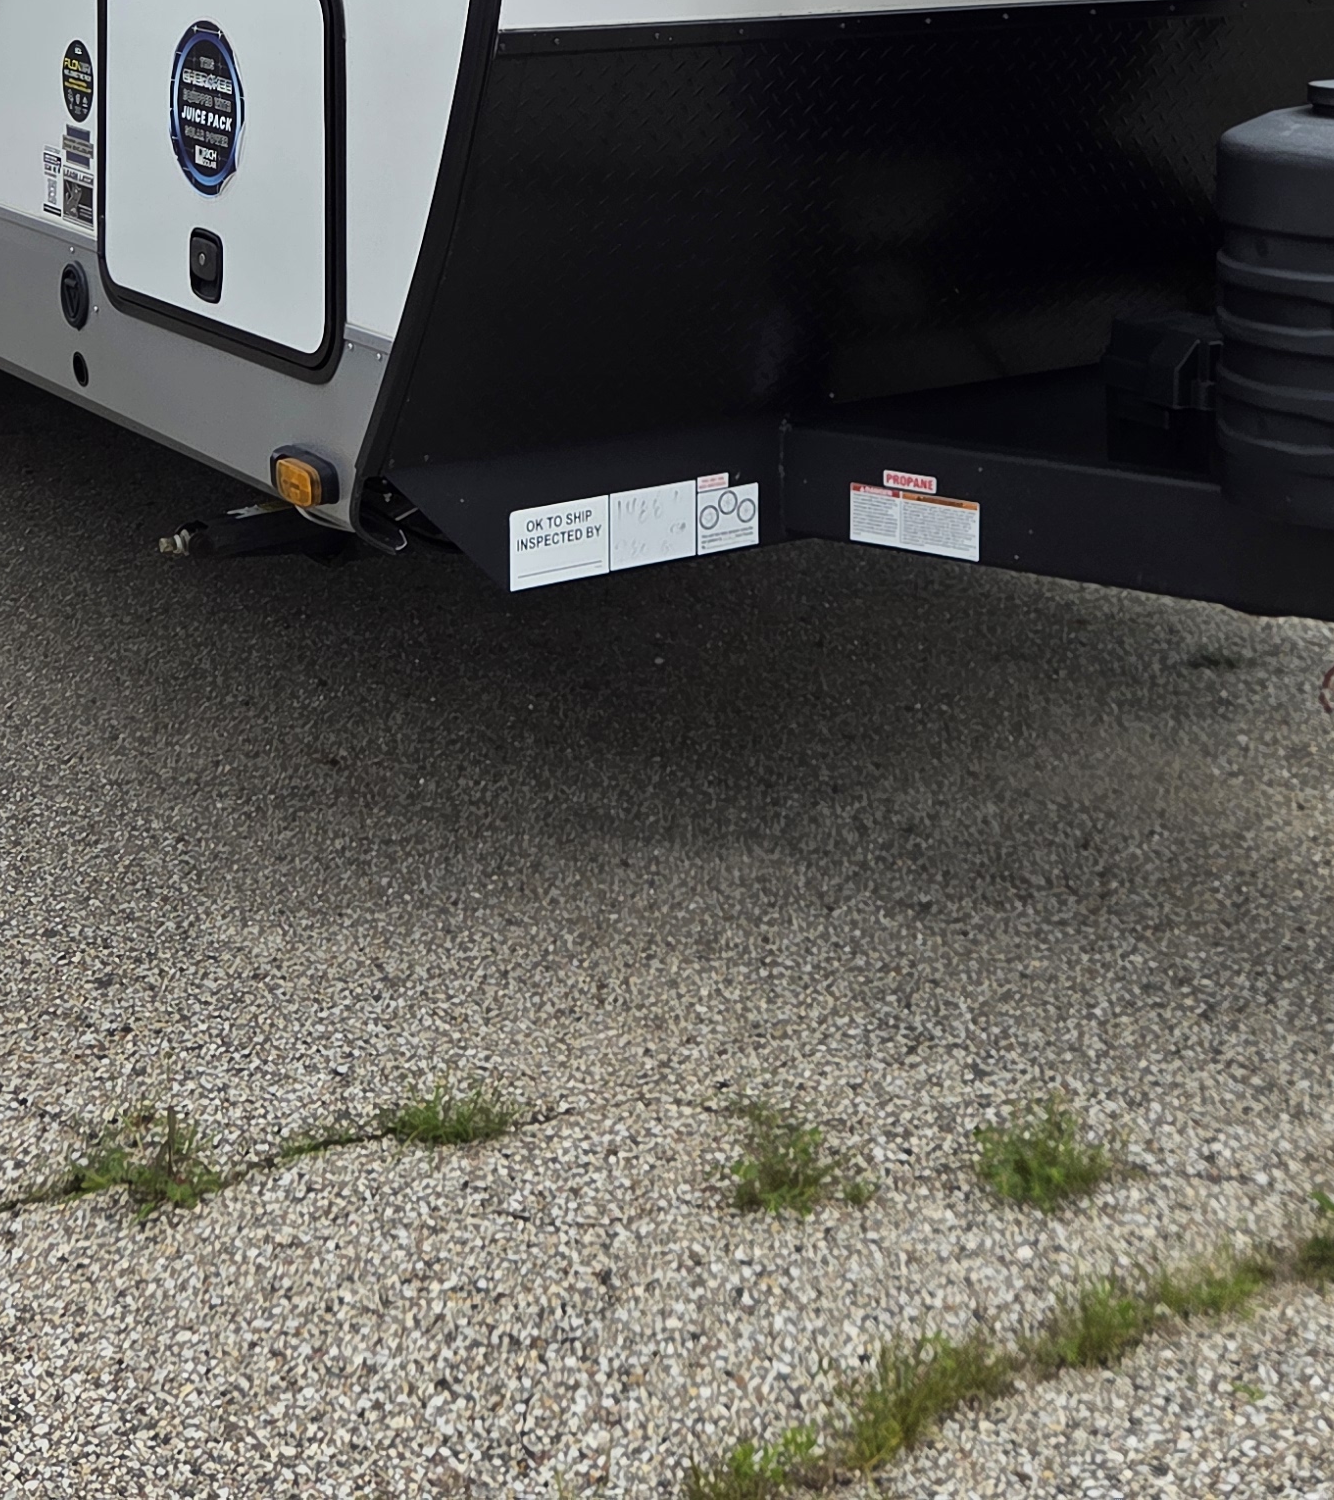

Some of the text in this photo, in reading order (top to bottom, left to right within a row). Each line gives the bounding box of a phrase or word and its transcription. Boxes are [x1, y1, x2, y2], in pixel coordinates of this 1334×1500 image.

[181, 105, 233, 132] JUICE PACK
[885, 473, 934, 491] PROPANE
[525, 509, 593, 533] OK TO SHIP
[516, 524, 602, 552] INSPECTED BY
